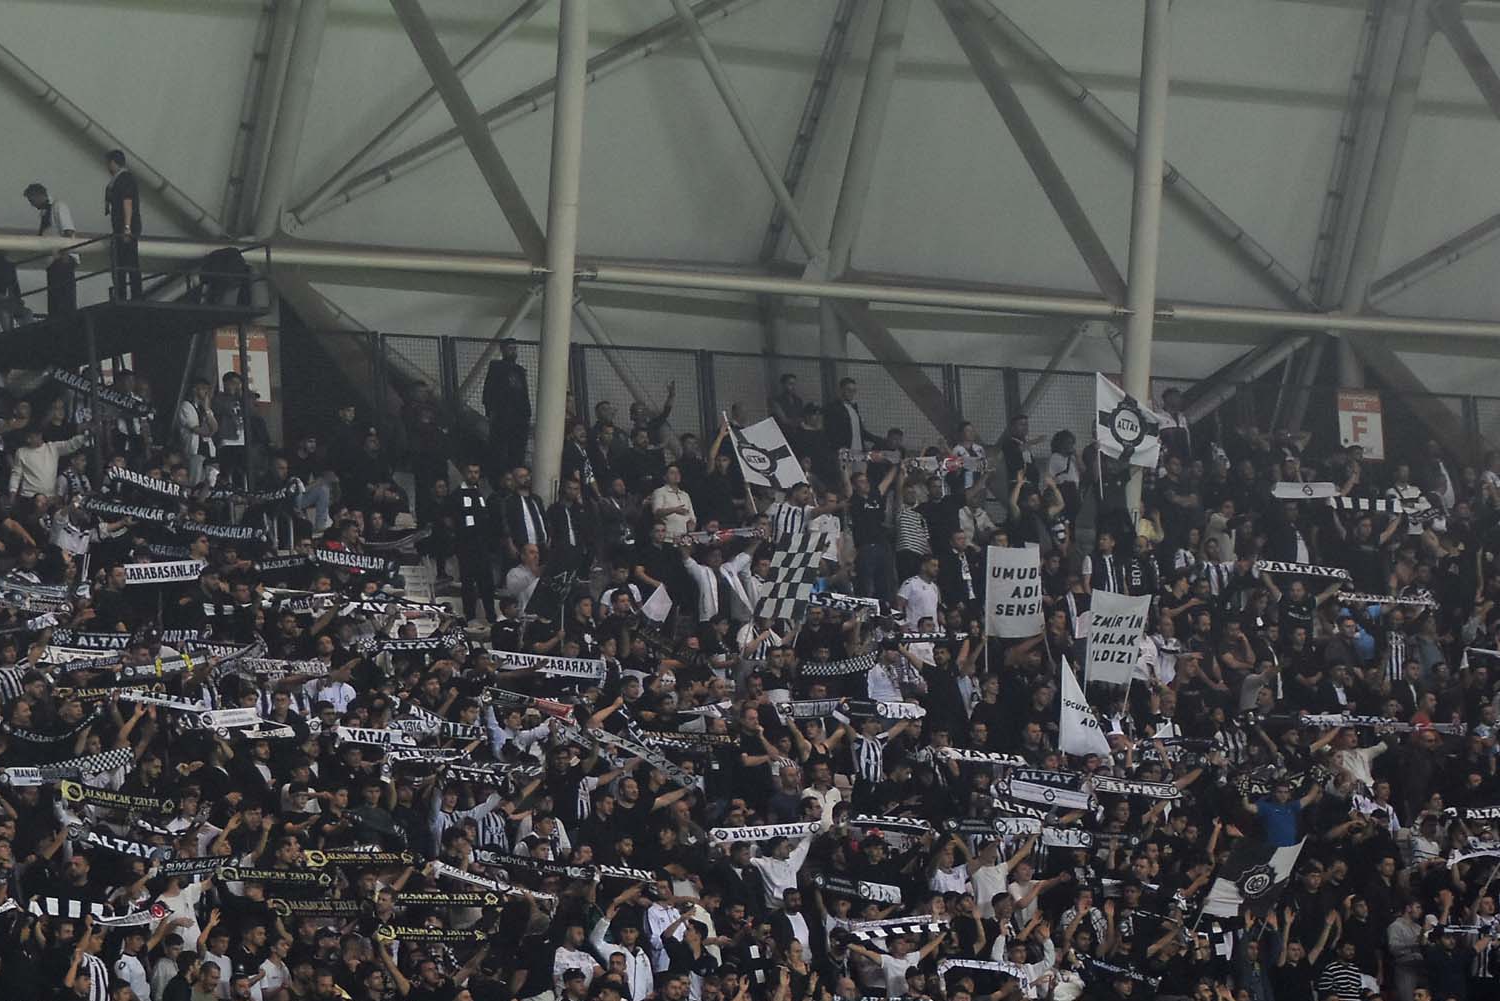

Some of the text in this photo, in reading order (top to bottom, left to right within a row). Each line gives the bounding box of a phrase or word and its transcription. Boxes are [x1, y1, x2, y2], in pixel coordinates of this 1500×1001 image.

[53, 369, 136, 408] KARABSANLAR
[1116, 419, 1140, 434] ALTAY
[1351, 416, 1368, 443] F
[316, 549, 385, 570] KARABASANLAR
[992, 566, 1040, 580] UMUD
[1271, 562, 1332, 578] ALTAY
[1091, 613, 1144, 629] ZMİR'İN
[77, 636, 129, 648] ALTAY
[382, 640, 439, 651] ALTAY
[1092, 650, 1133, 664] LDIZI
[1019, 772, 1072, 785] ALTAY
[1251, 775, 1305, 794] ALY
[1106, 780, 1162, 797] ALTAY
[992, 799, 1048, 820] ALTAY
[733, 825, 804, 840] BÜYÜK ALTAY
[87, 830, 158, 861] ALTAY
[165, 856, 228, 873] BÜYÜK ALTAY
[601, 863, 653, 881] ALTAY
